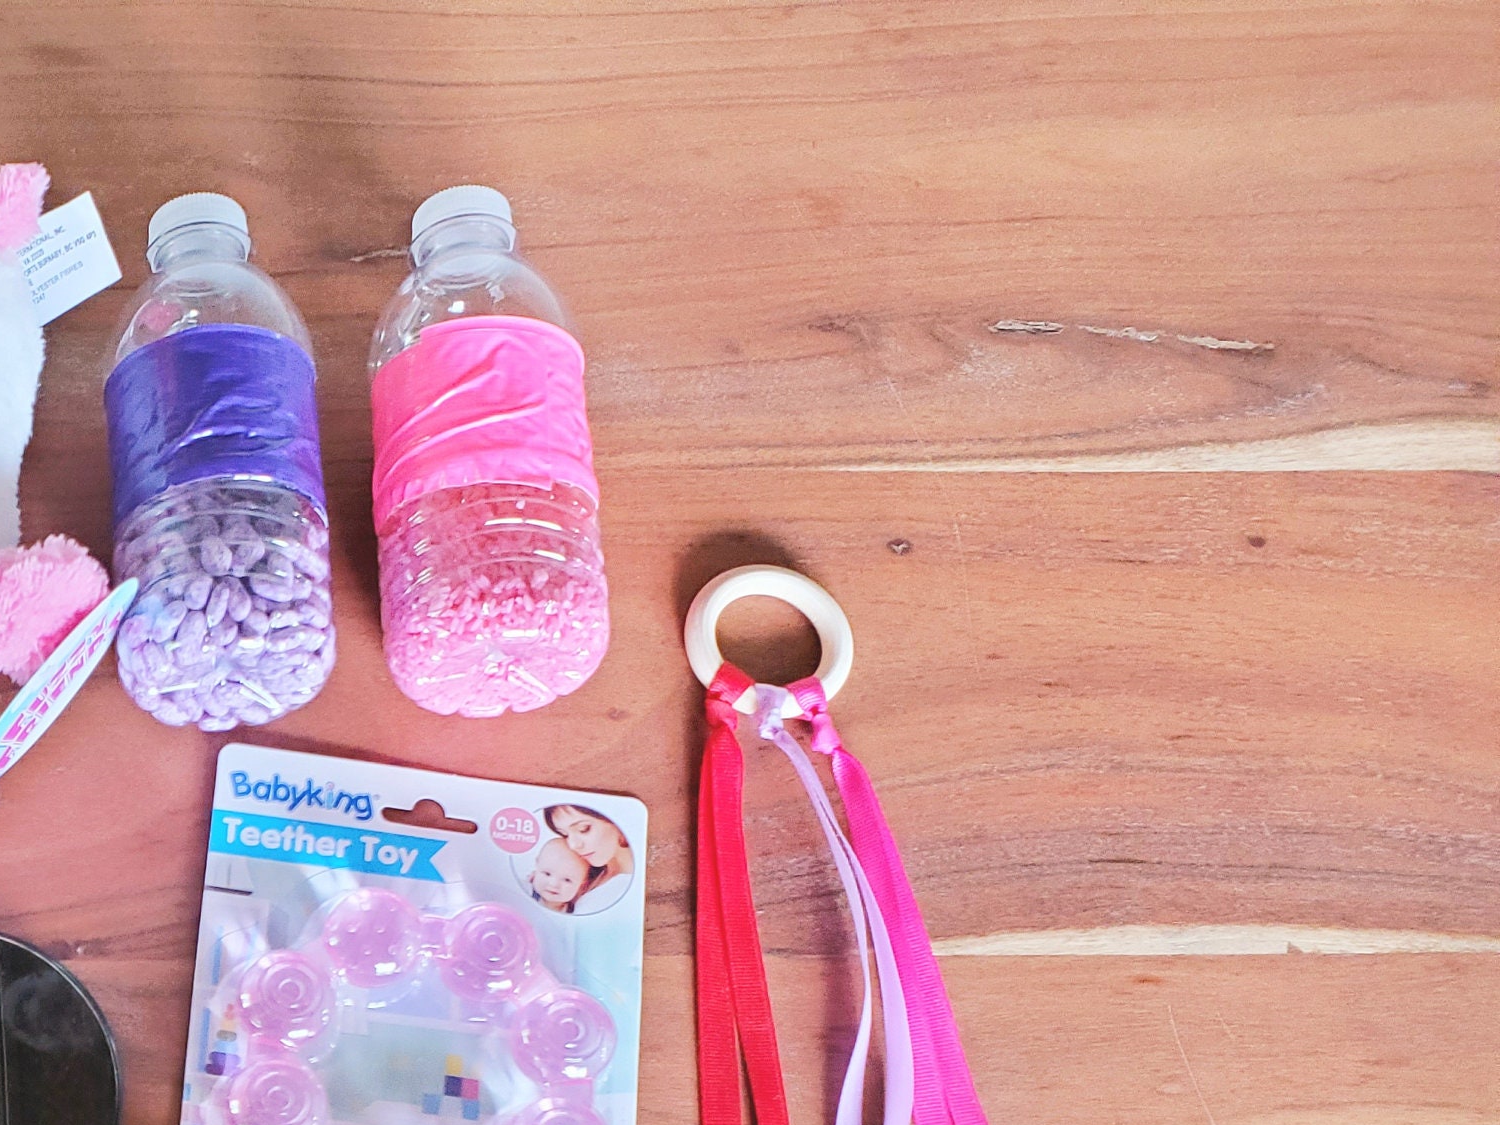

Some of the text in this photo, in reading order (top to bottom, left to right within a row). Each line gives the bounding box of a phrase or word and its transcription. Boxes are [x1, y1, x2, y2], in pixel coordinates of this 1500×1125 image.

[230, 770, 374, 820] Babyking
[222, 816, 419, 875] Teether Toy
[495, 816, 534, 834] 0-18
